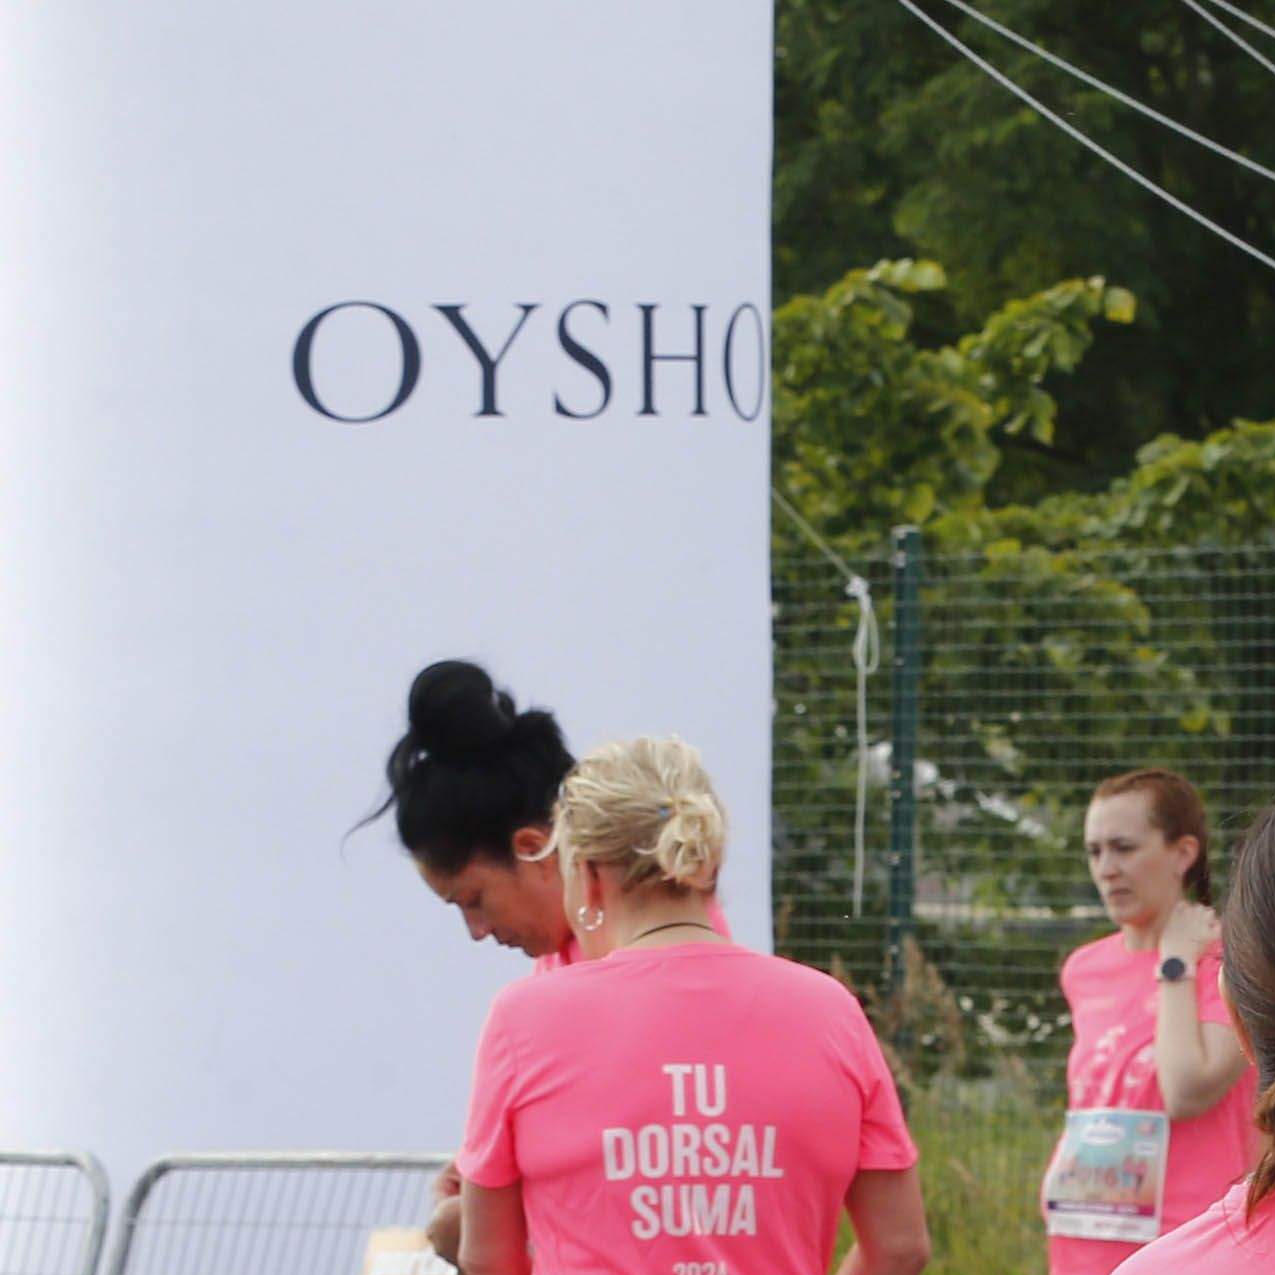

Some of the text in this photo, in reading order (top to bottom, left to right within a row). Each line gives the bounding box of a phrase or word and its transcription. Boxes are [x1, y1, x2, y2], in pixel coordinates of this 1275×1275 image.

[291, 300, 766, 424] OYSHO
[662, 1063, 728, 1118] TU
[602, 1124, 784, 1182] DORSAL
[629, 1184, 759, 1240] SUMA
